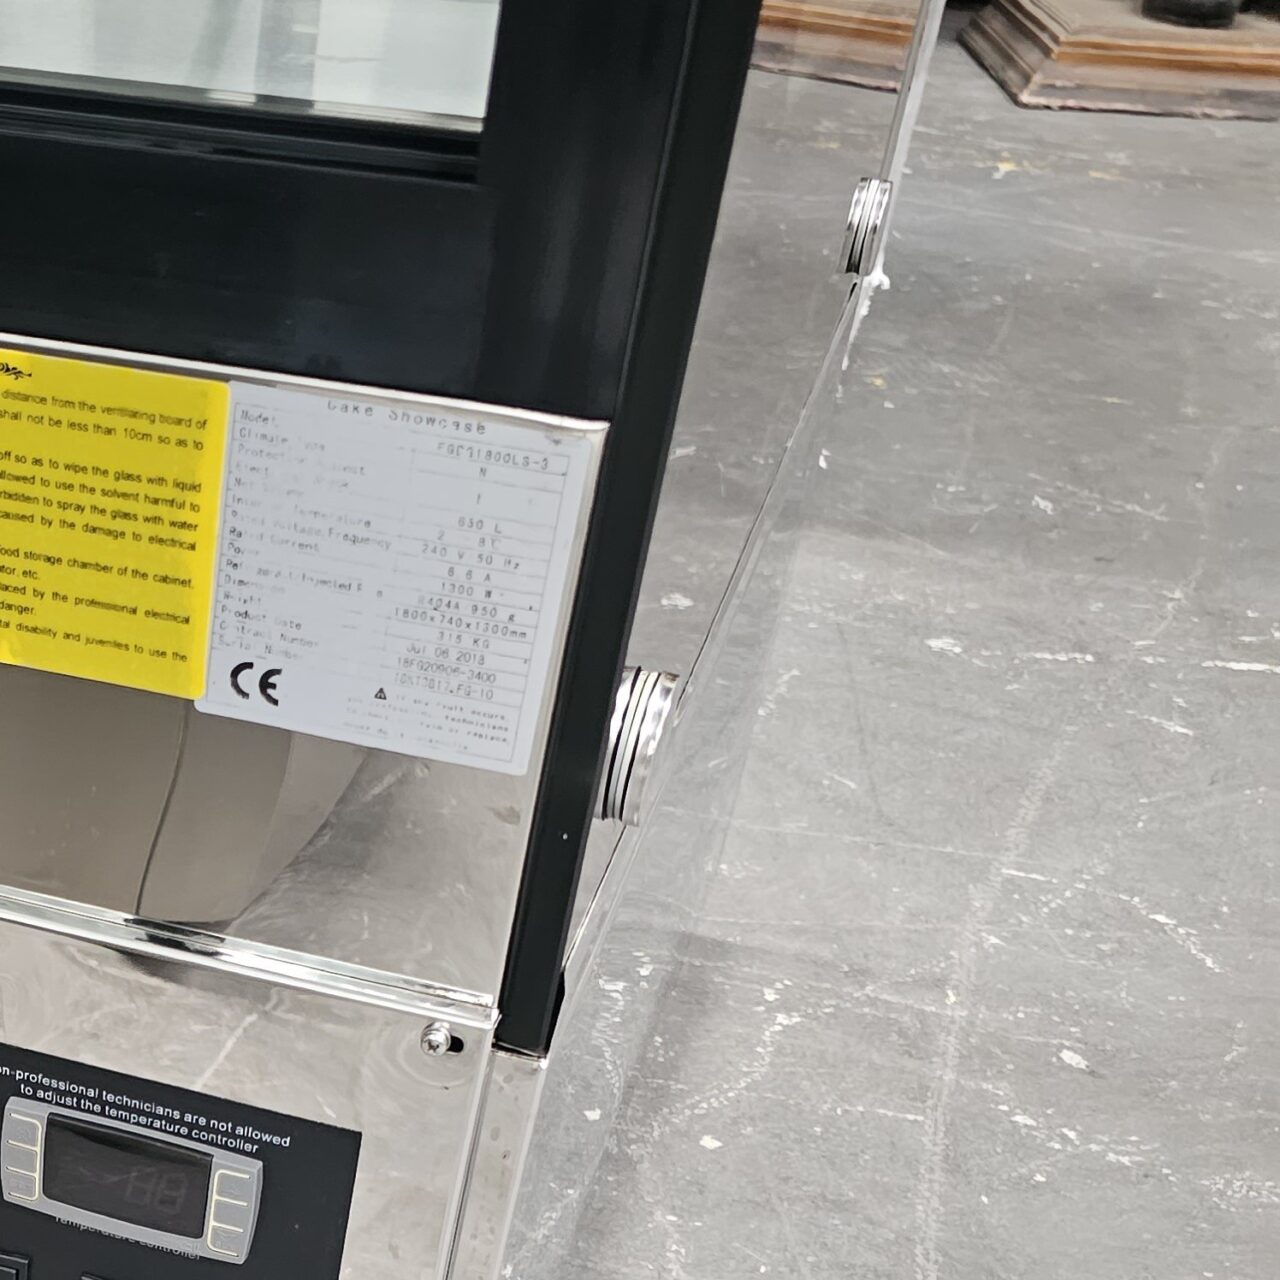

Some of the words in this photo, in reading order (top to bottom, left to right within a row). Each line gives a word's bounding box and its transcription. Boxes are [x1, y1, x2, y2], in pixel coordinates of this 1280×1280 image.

[26, 413, 45, 426] not
[66, 419, 90, 433] less
[92, 423, 118, 437] than
[23, 550, 64, 567] storage
[66, 557, 114, 574] chamber
[130, 568, 150, 582] the
[440, 581, 474, 597] 1300
[20, 1082, 34, 1096] to
[36, 1089, 78, 1108] adjust
[80, 1098, 102, 1113] the
[104, 1104, 189, 1136] temperature
[191, 1128, 260, 1154] controller
[101, 1089, 181, 1120] technicians
[183, 1112, 207, 1127] are
[209, 1119, 233, 1134] not
[234, 1125, 291, 1148] allowed
